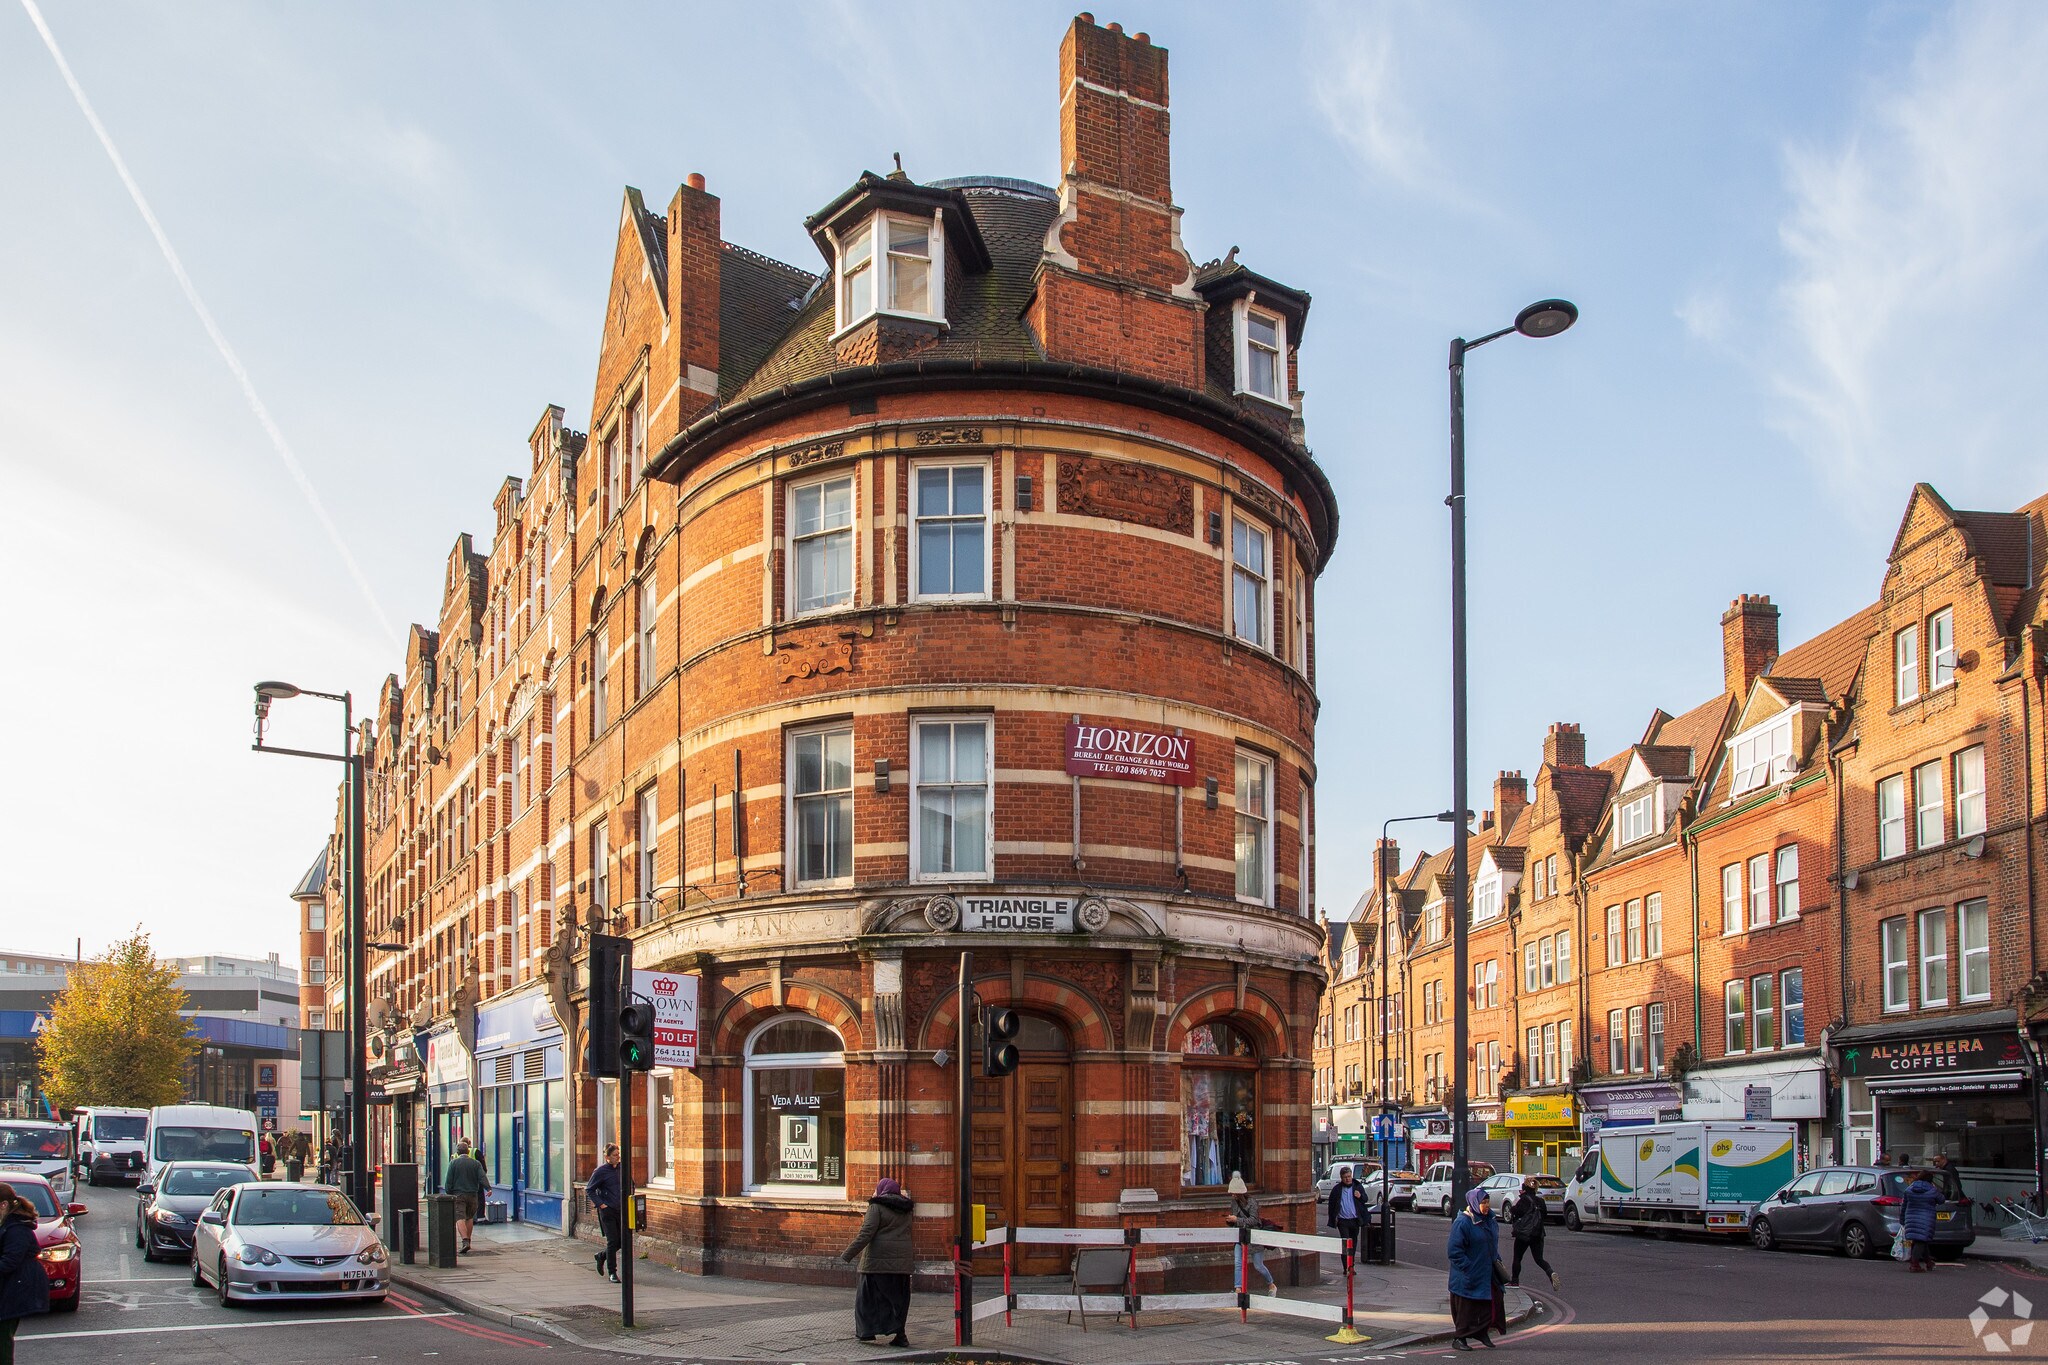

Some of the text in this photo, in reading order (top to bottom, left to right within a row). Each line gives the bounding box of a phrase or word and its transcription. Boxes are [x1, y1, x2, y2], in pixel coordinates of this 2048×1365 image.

[1074, 726, 1191, 760] HORIZON
[1074, 751, 1102, 760] BUREAU
[1114, 755, 1142, 764] CHANGE
[1149, 759, 1167, 767] BABY
[1167, 761, 1190, 770] WORLD
[1093, 762, 1167, 778] TEL: 020 8696 7025
[966, 900, 1068, 915] TRIANGLE
[736, 912, 800, 939] BANK
[982, 915, 1055, 930] HOUSE
[661, 1031, 675, 1042] TO
[677, 1033, 694, 1043] LET
[672, 1049, 690, 1057] 1111
[1871, 1038, 1984, 1059] AL-JAZEERA
[1890, 1055, 1957, 1070] COFFEE
[1607, 1092, 1635, 1101] Dahab
[1527, 1103, 1548, 1111] SOMALI
[1612, 1107, 1646, 1116] International
[1529, 1112, 1561, 1120] RESTAURANT
[795, 1124, 803, 1139] P
[784, 1147, 813, 1159] PALM
[1656, 1143, 1671, 1154] Group
[1717, 1143, 1757, 1153] phs Group
[786, 1161, 812, 1169] TO LET
[368, 1269, 374, 1277] X
